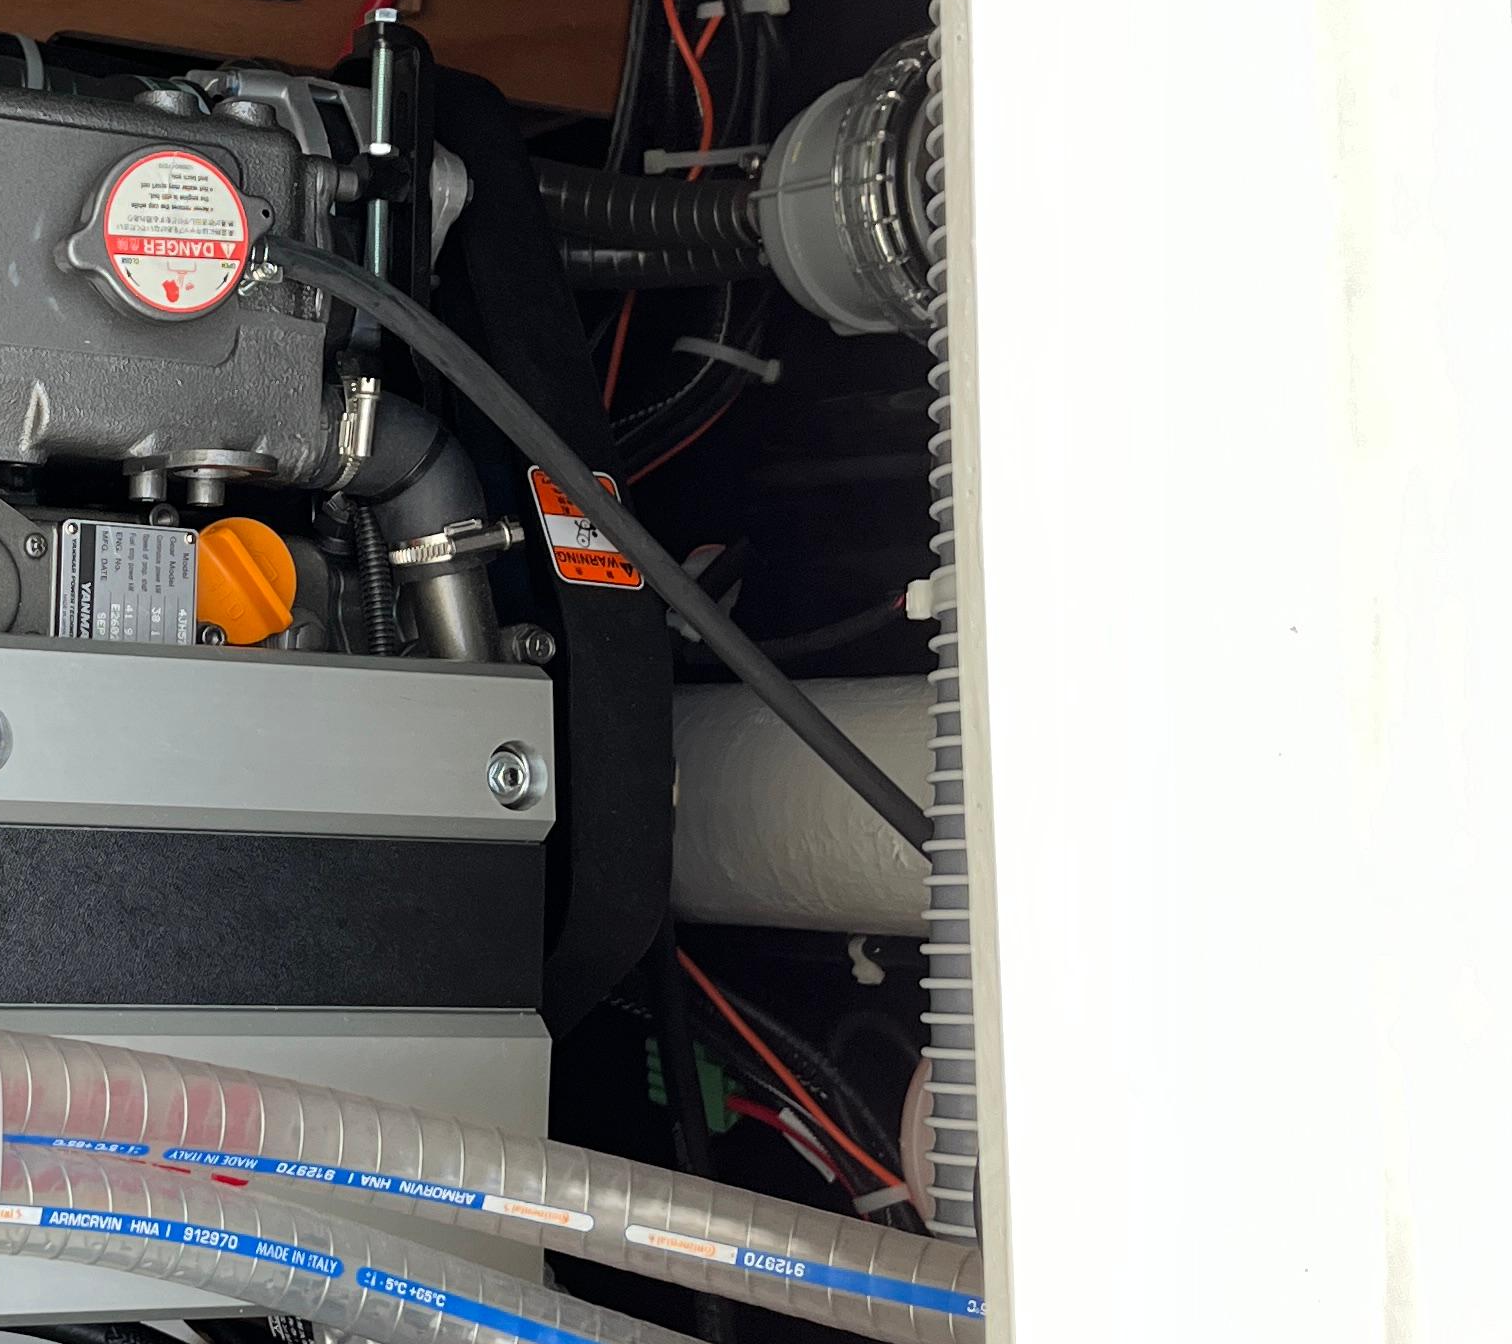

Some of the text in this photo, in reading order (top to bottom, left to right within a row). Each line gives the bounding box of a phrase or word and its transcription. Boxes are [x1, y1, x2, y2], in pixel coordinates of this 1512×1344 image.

[142, 235, 215, 260] DANGER
[100, 558, 108, 580] DATE
[181, 552, 189, 579] Model
[556, 548, 619, 570] WARNING
[78, 581, 91, 639] YANMA
[96, 611, 105, 635] SEP
[169, 1149, 257, 1170] MADE IN ITALY
[275, 1161, 335, 1180] 912970
[360, 1174, 391, 1189] HNA
[399, 1180, 475, 1205] ARMORVIN
[129, 1218, 160, 1236] HNA
[182, 1226, 238, 1249] 912970
[254, 1241, 338, 1274] MADE IN ITALY
[742, 1251, 805, 1277] 912970
